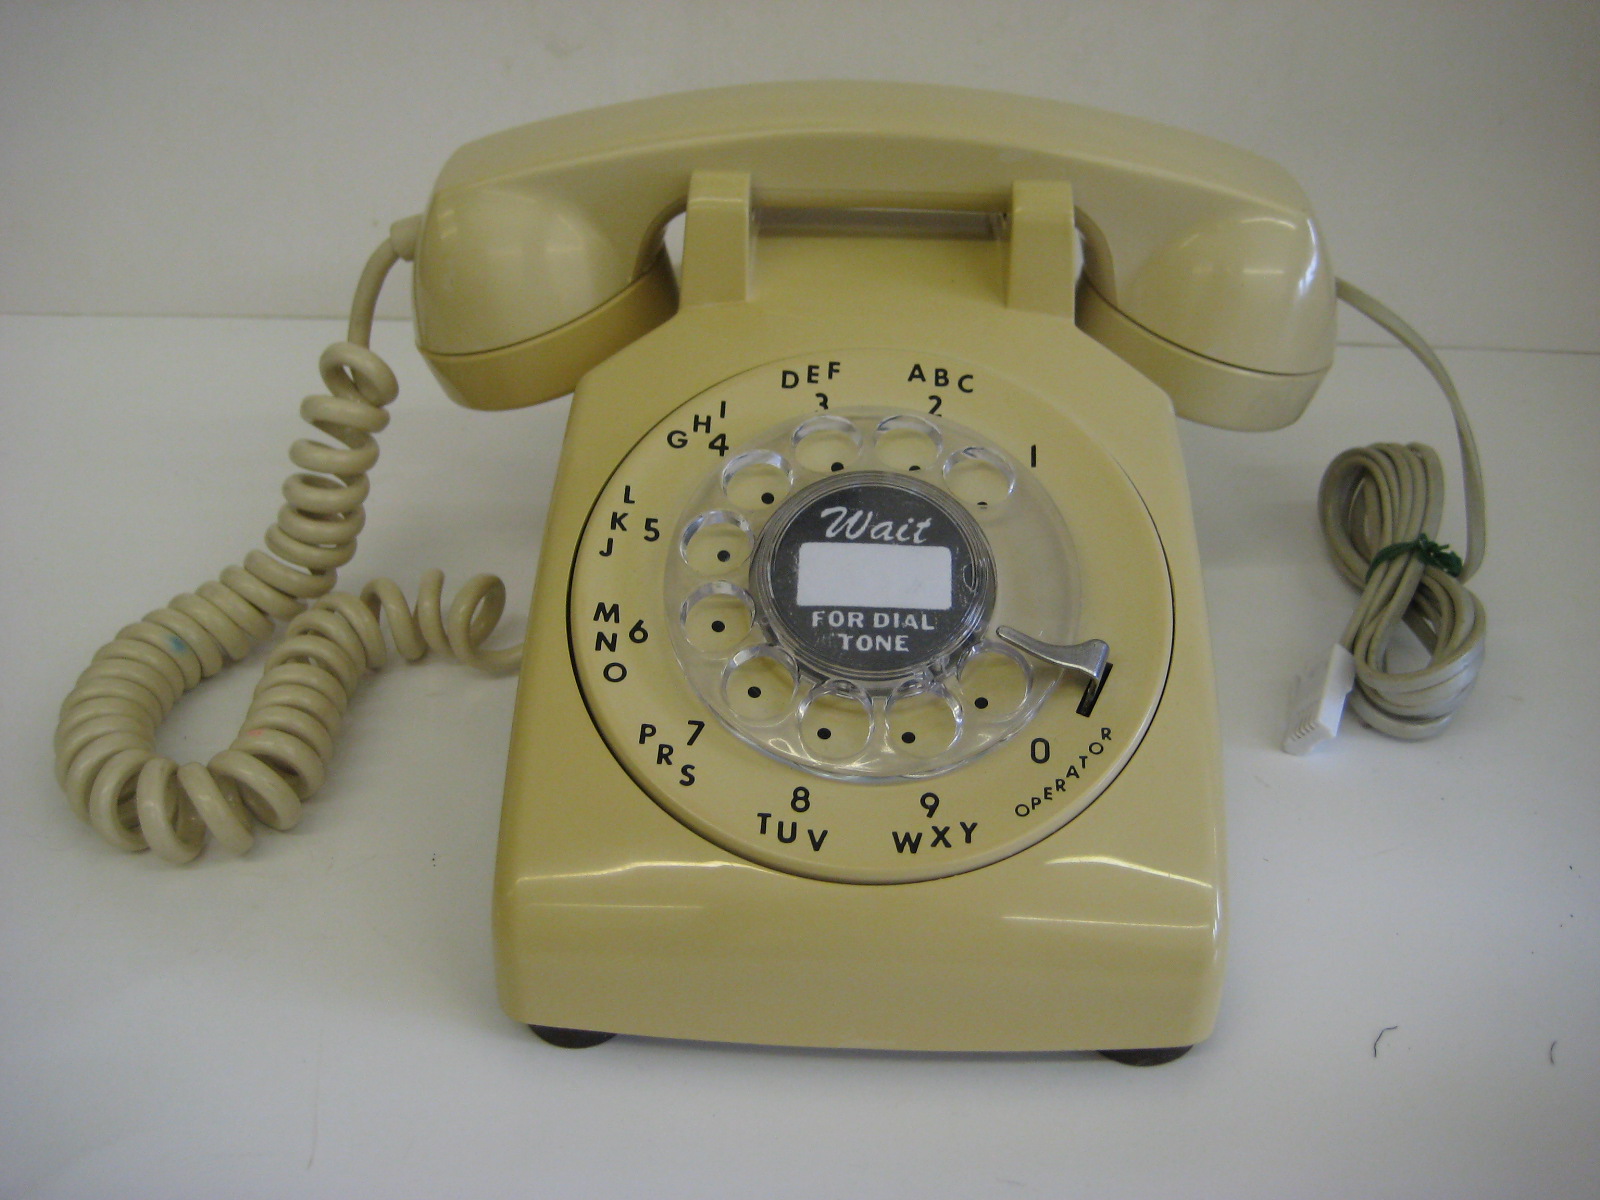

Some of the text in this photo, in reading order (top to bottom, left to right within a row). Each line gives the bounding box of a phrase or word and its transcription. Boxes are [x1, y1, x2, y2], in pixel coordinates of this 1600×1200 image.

[781, 361, 841, 389] DEF
[907, 363, 974, 393] ABC
[928, 394, 943, 418] 2
[666, 400, 728, 449] GHI
[708, 433, 730, 458] 4
[643, 517, 660, 543] 5
[820, 506, 932, 544] Wait
[628, 619, 649, 644] 6
[811, 610, 935, 631] FOR DIAL
[837, 633, 909, 652] TONE
[686, 719, 706, 746] 7
[638, 723, 696, 787] PRS
[1014, 727, 1113, 818] OPERATOR
[790, 786, 811, 813] 8
[919, 792, 940, 819] 9
[757, 812, 829, 852] TUV
[892, 821, 978, 855] WXY
